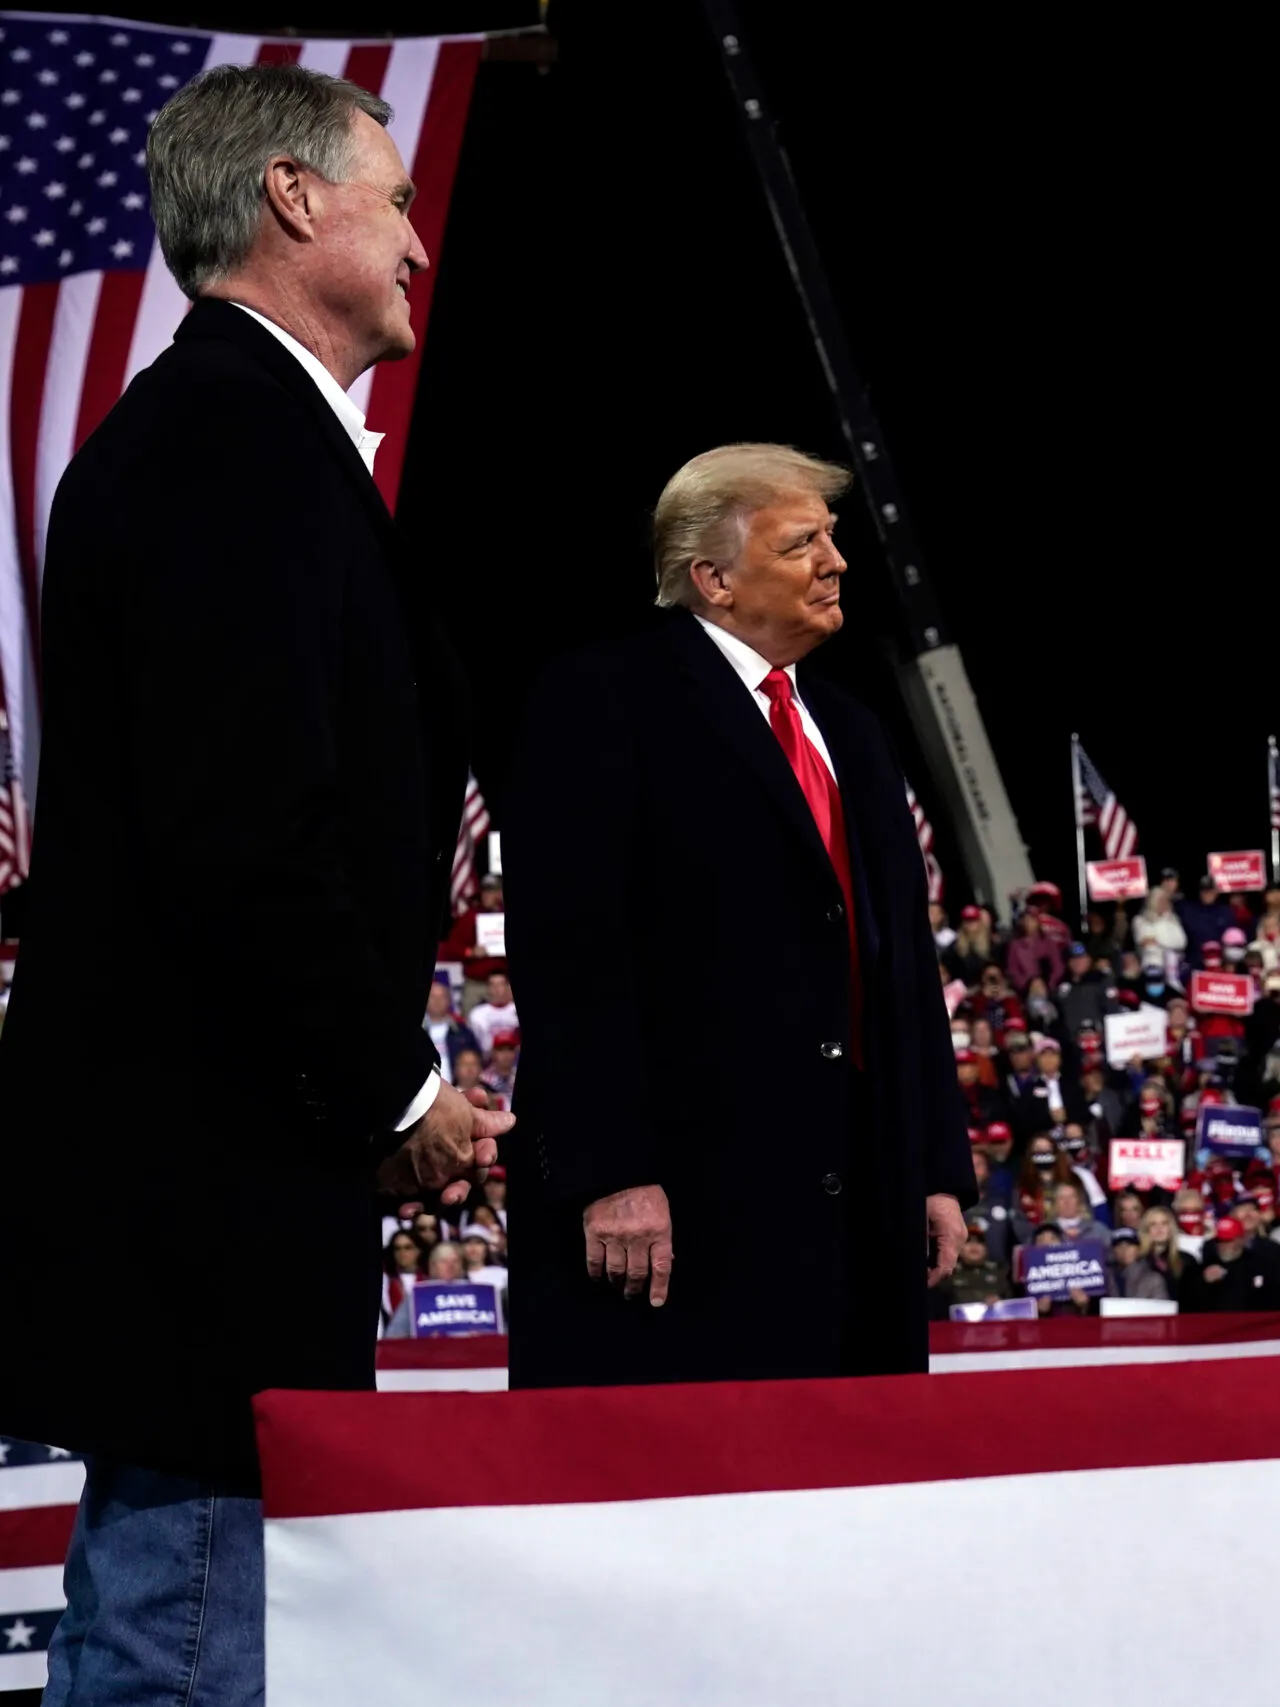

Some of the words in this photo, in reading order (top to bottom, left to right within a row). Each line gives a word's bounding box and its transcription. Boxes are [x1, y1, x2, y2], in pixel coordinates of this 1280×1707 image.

[1027, 1259, 1103, 1281] AMERICA
[435, 1294, 476, 1309] SAVE
[418, 1310, 495, 1328] AMERICA!
